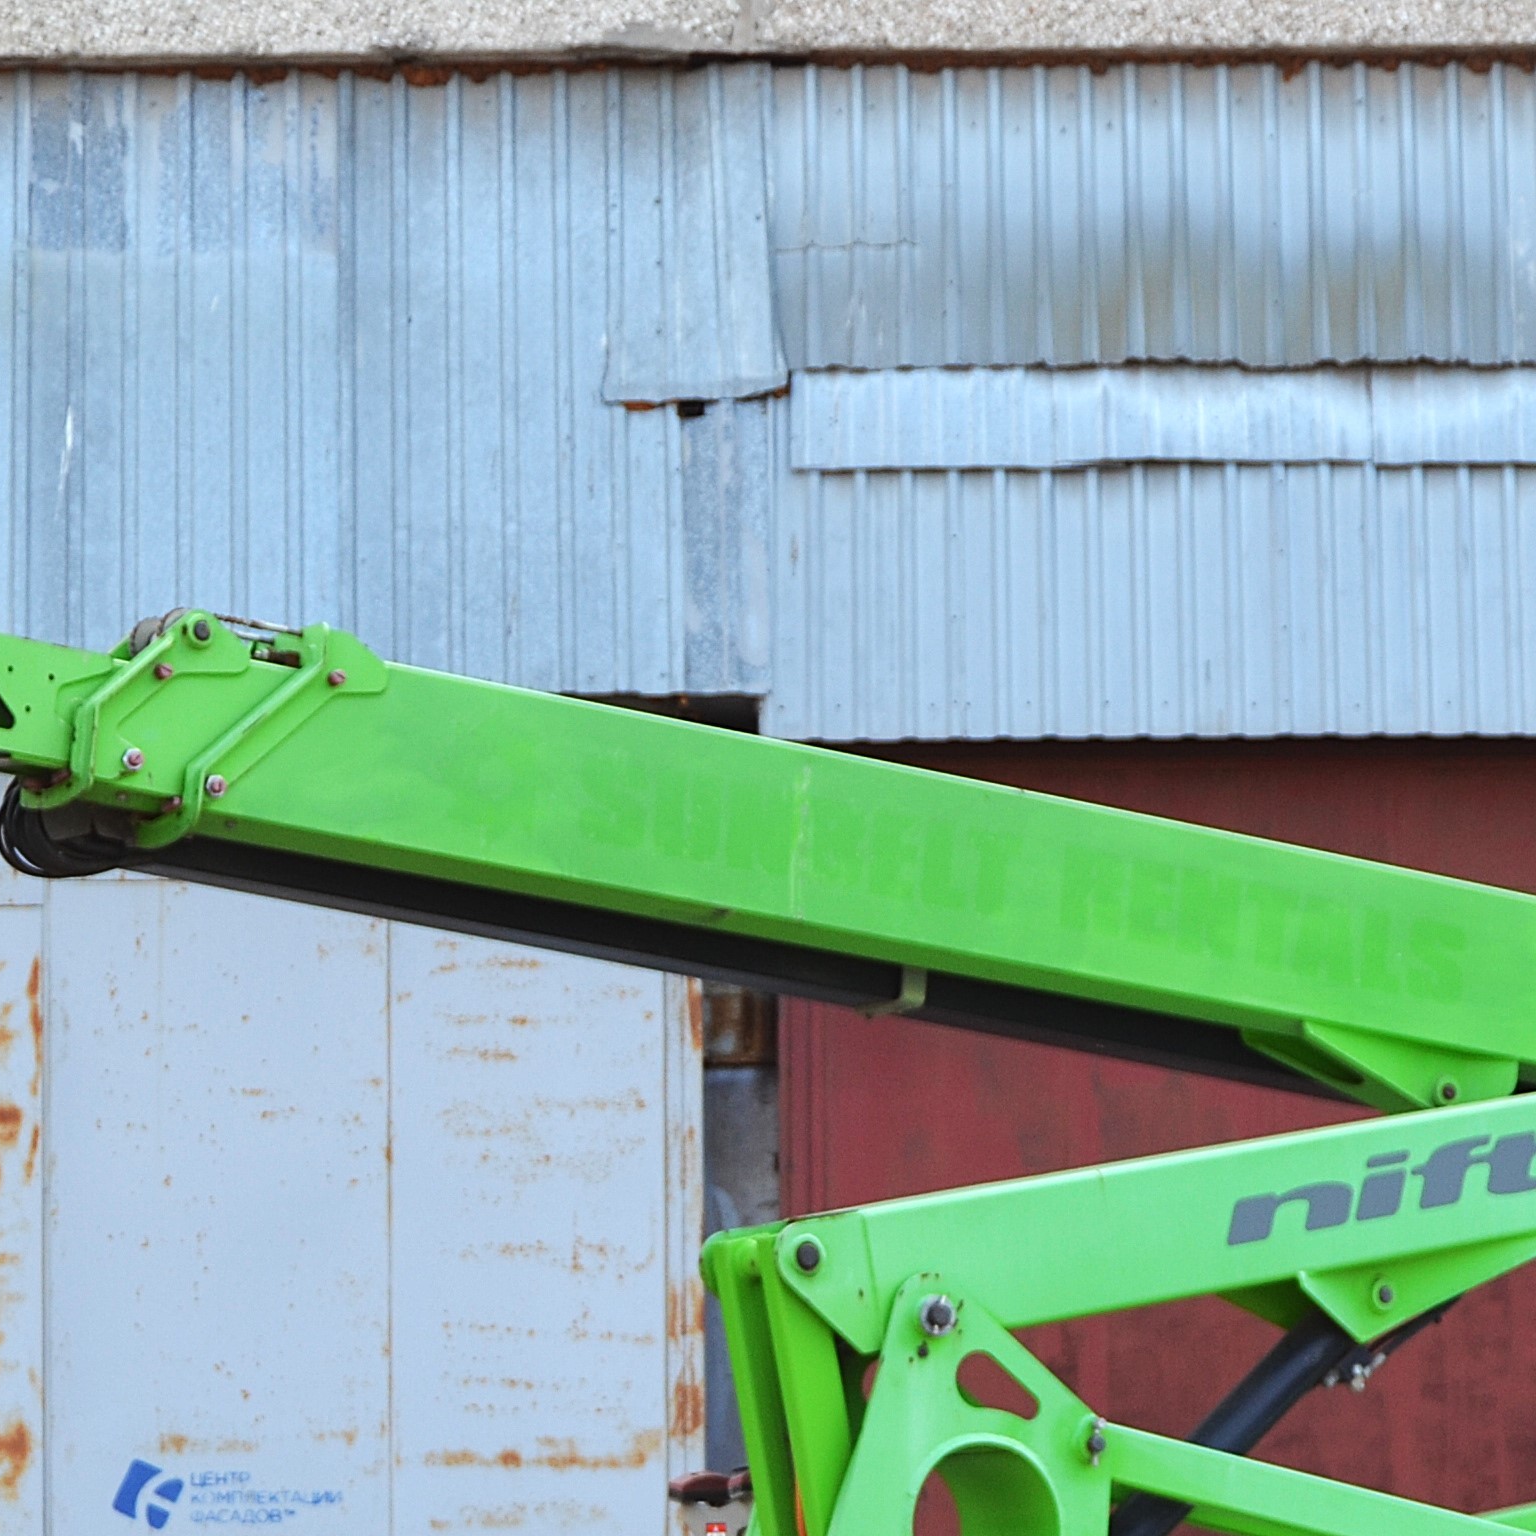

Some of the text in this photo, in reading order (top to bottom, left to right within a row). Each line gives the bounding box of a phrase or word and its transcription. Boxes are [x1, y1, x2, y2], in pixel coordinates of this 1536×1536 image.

[1059, 844, 1468, 1004] RENTALS
[190, 1471, 251, 1486] ЦЕНТР
[190, 1490, 343, 1504] КОМПЛЕКТАЦИИ
